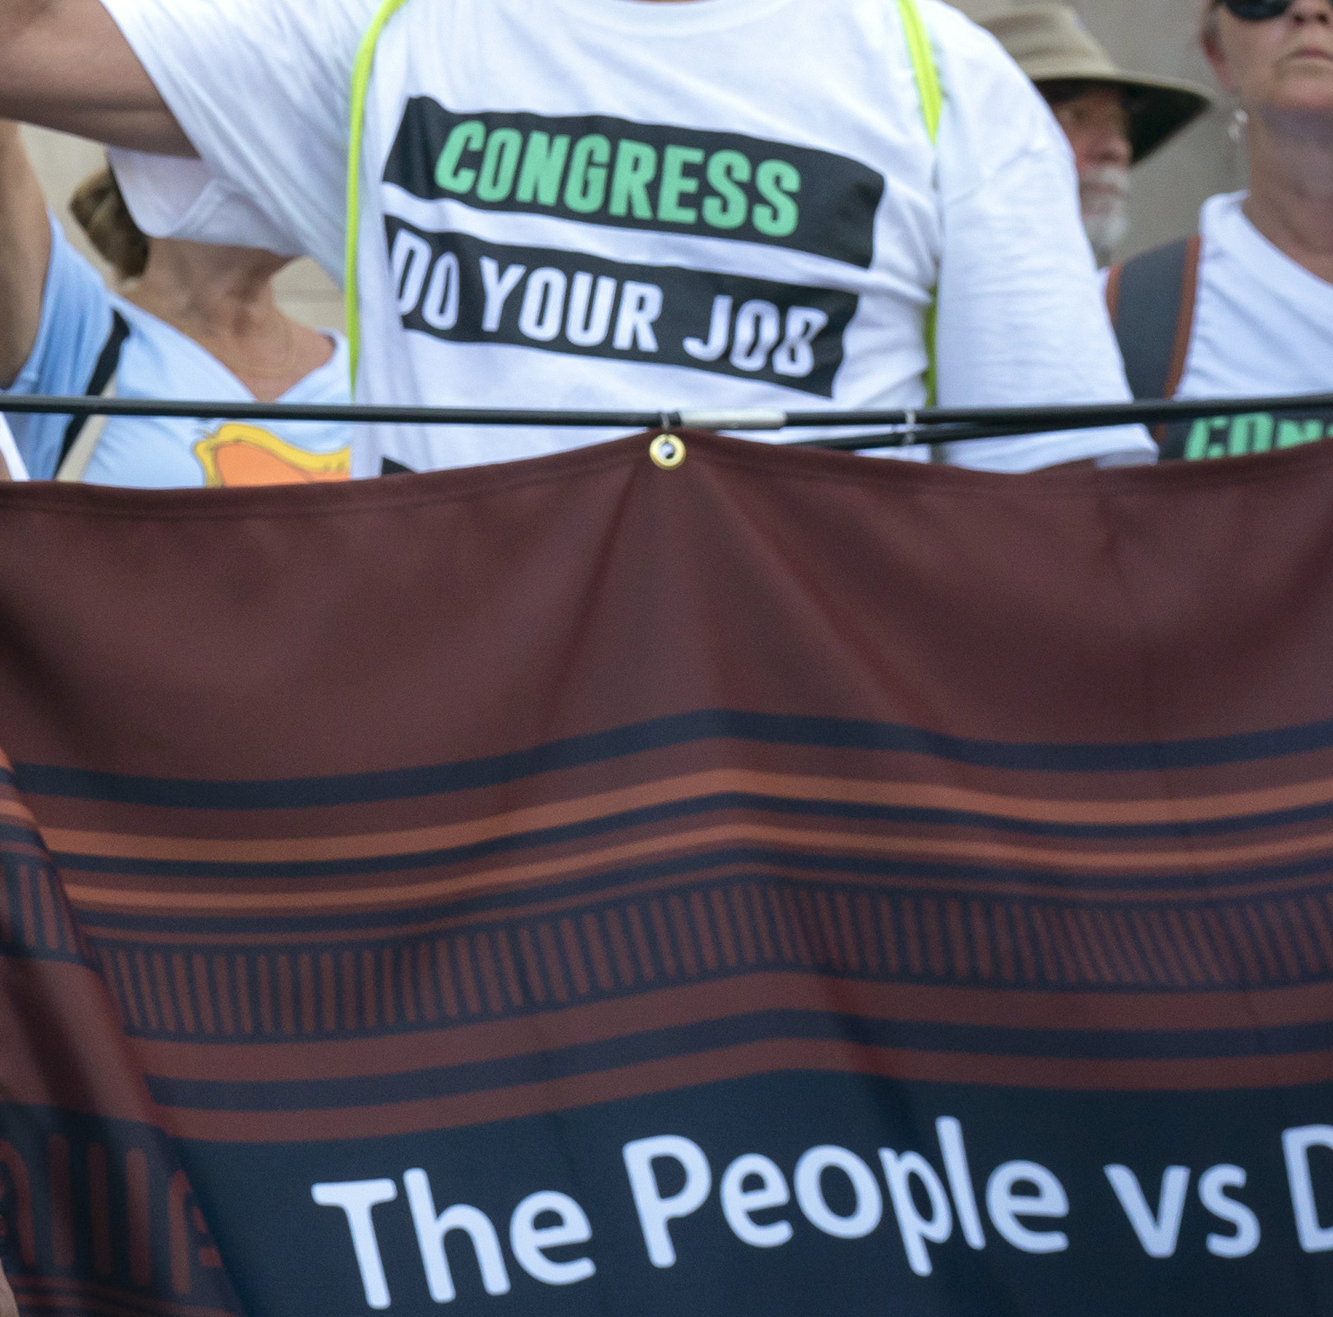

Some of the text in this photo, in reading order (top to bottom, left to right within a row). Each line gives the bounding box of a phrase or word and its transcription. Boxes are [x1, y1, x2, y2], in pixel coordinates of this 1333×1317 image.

[434, 119, 801, 237] CONGRESS
[390, 227, 830, 378] DO YOUR JOB
[1185, 411, 1333, 462] CON
[310, 1167, 597, 1309] The
[622, 1115, 1070, 1277] People
[1102, 1162, 1262, 1259] vs
